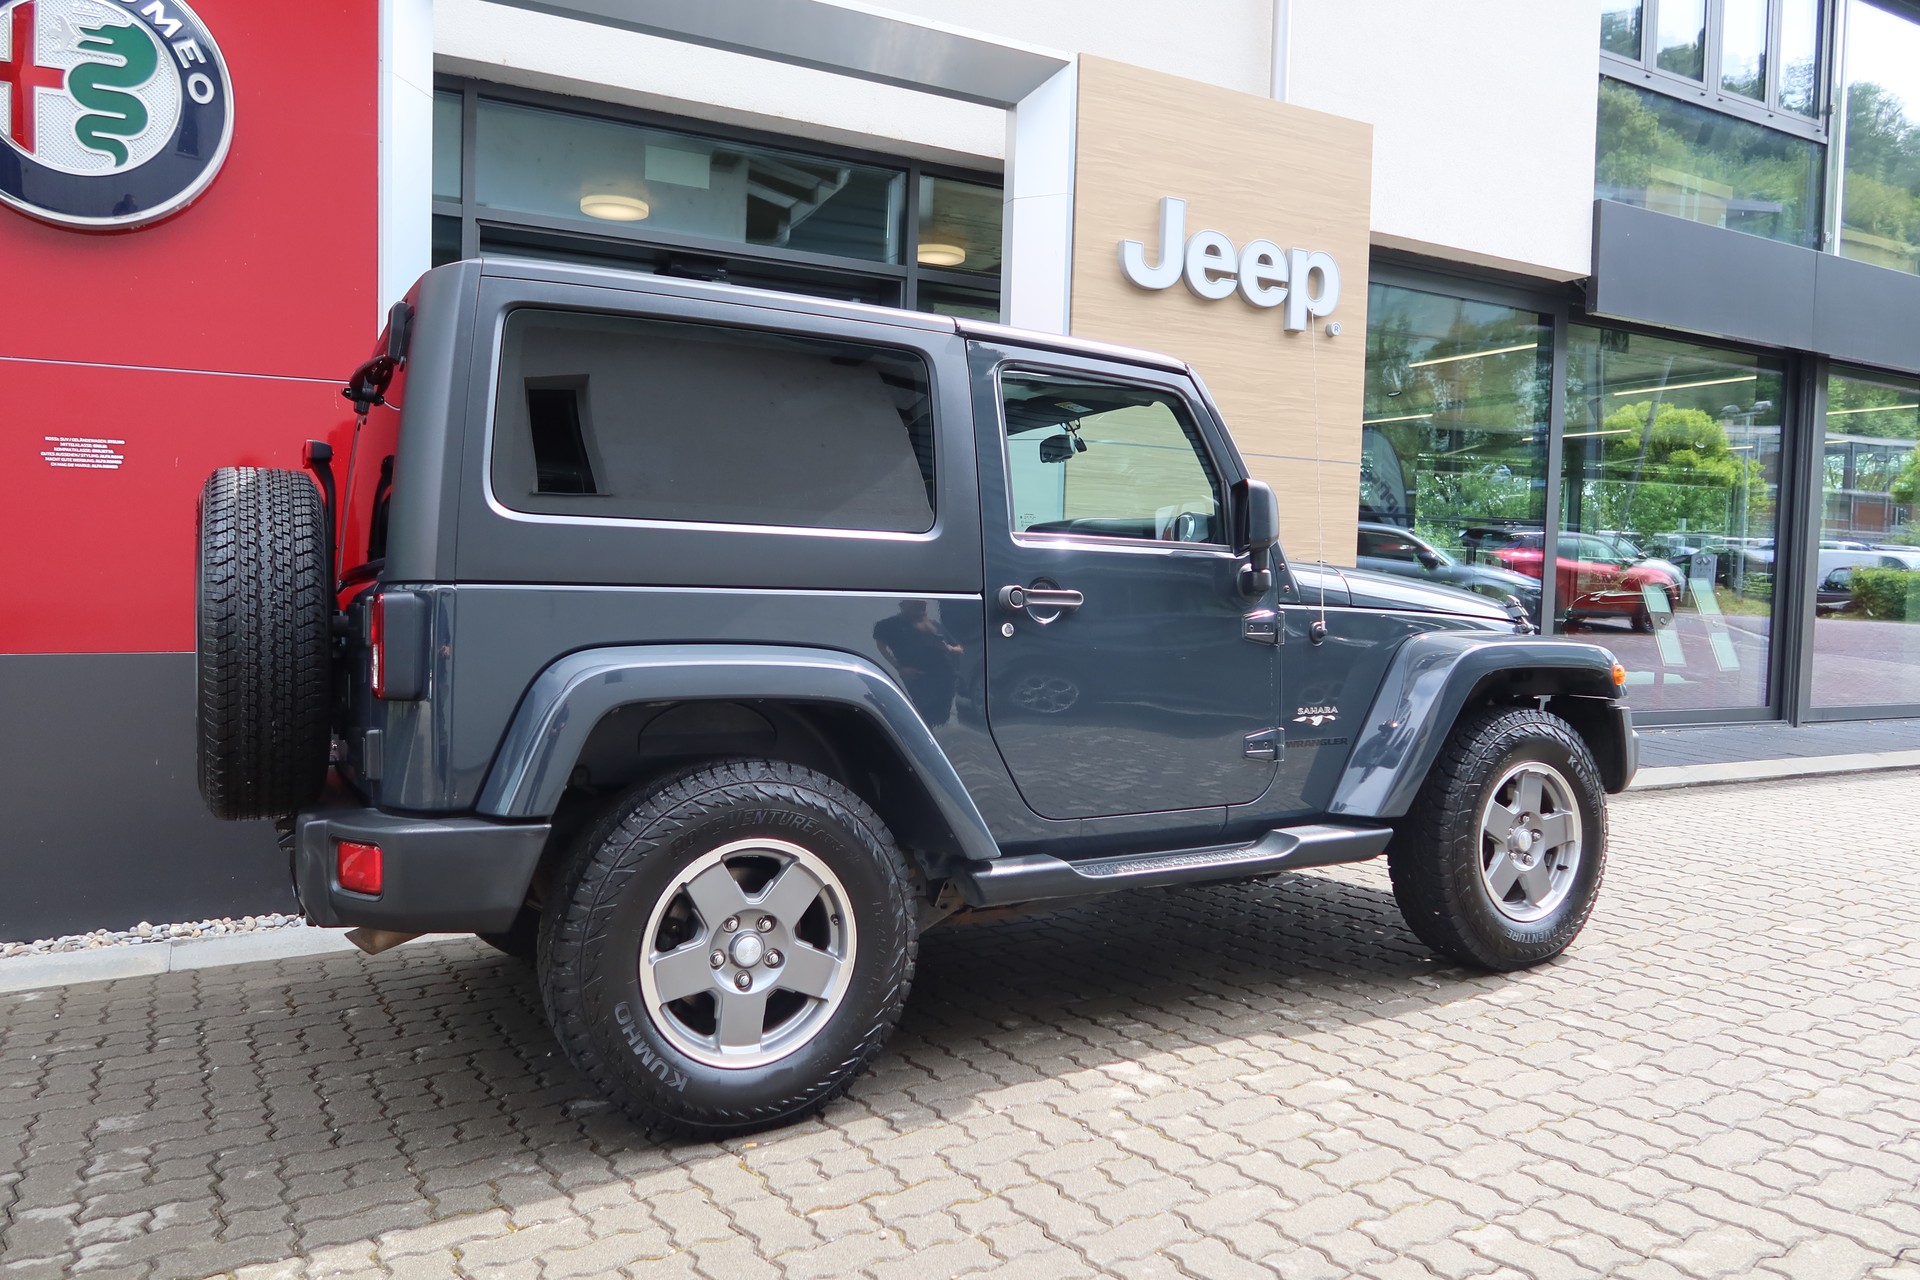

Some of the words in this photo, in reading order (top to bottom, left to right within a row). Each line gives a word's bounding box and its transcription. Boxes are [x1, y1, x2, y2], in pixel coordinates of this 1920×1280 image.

[123, 0, 215, 105] MEO
[1297, 706, 1339, 716] SAHARA
[1286, 736, 1348, 748] WRANGLER
[614, 1000, 689, 1093] KUMHO
